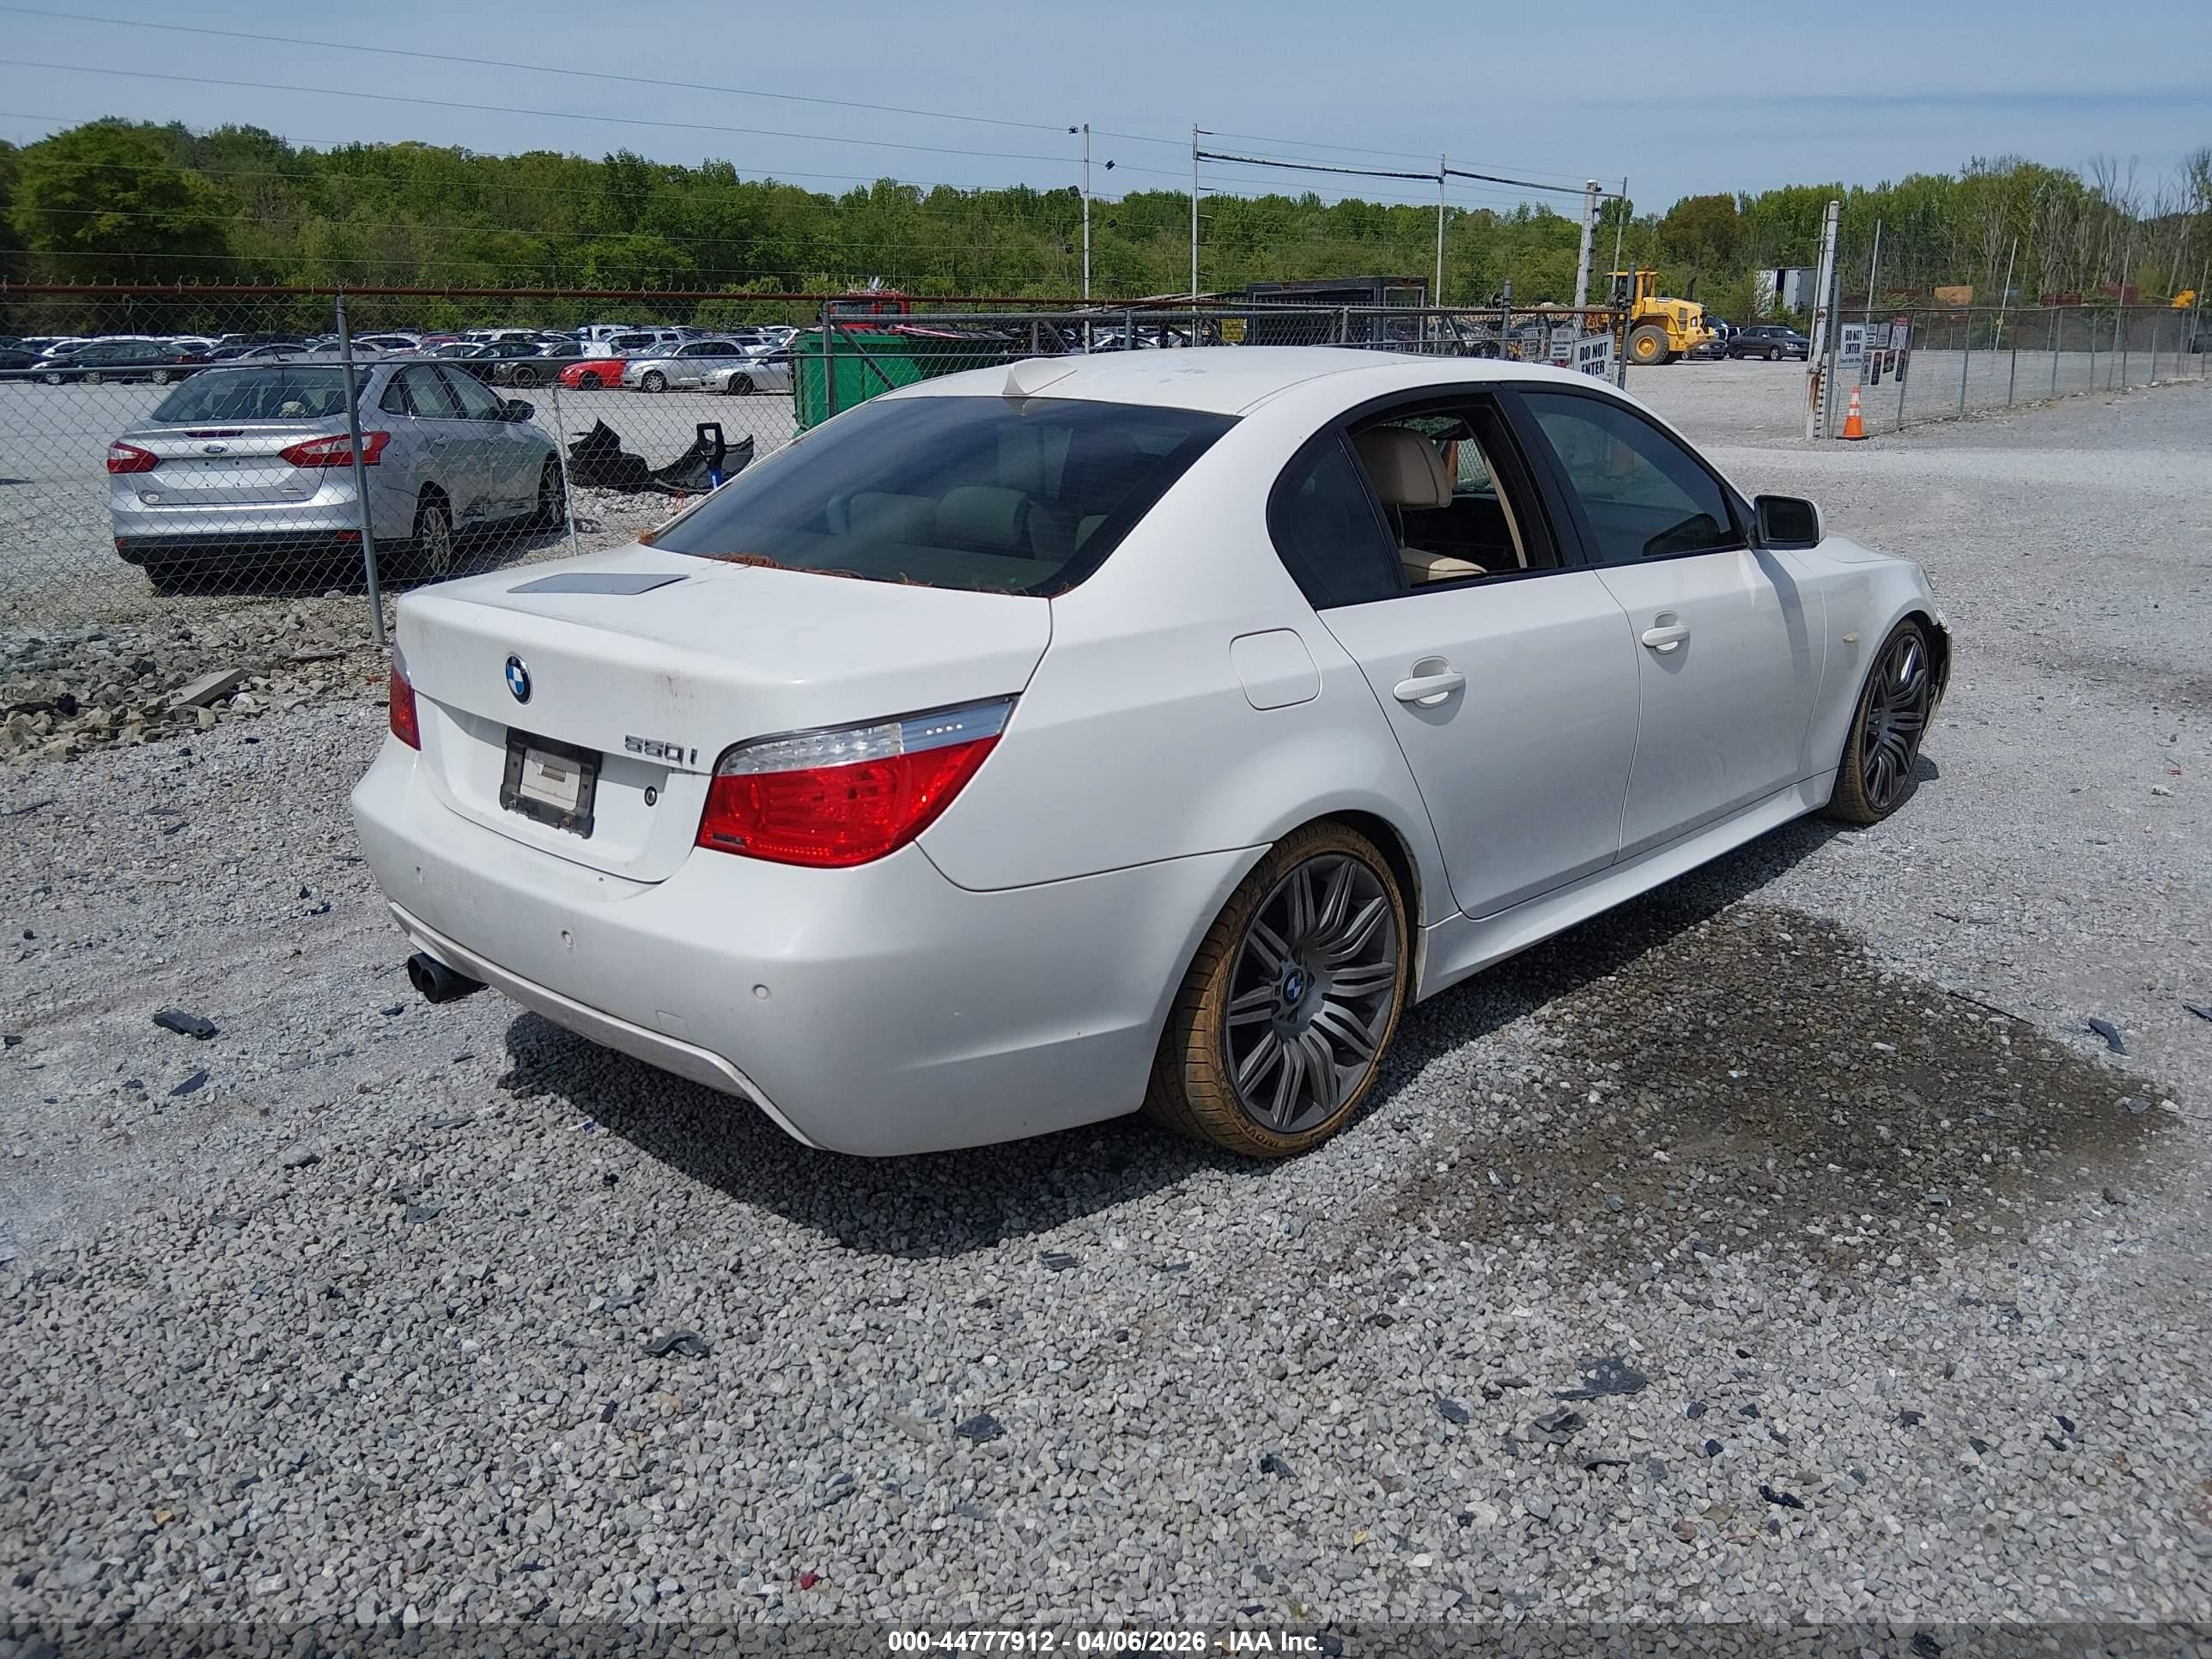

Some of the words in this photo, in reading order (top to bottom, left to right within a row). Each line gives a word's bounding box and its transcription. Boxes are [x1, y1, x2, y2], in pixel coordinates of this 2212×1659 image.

[1853, 330, 1862, 341] NOT
[1580, 346, 1590, 361] DO
[1592, 342, 1608, 358] NOT
[1845, 343, 1860, 354] ENTER
[1581, 361, 1605, 375] ENTER
